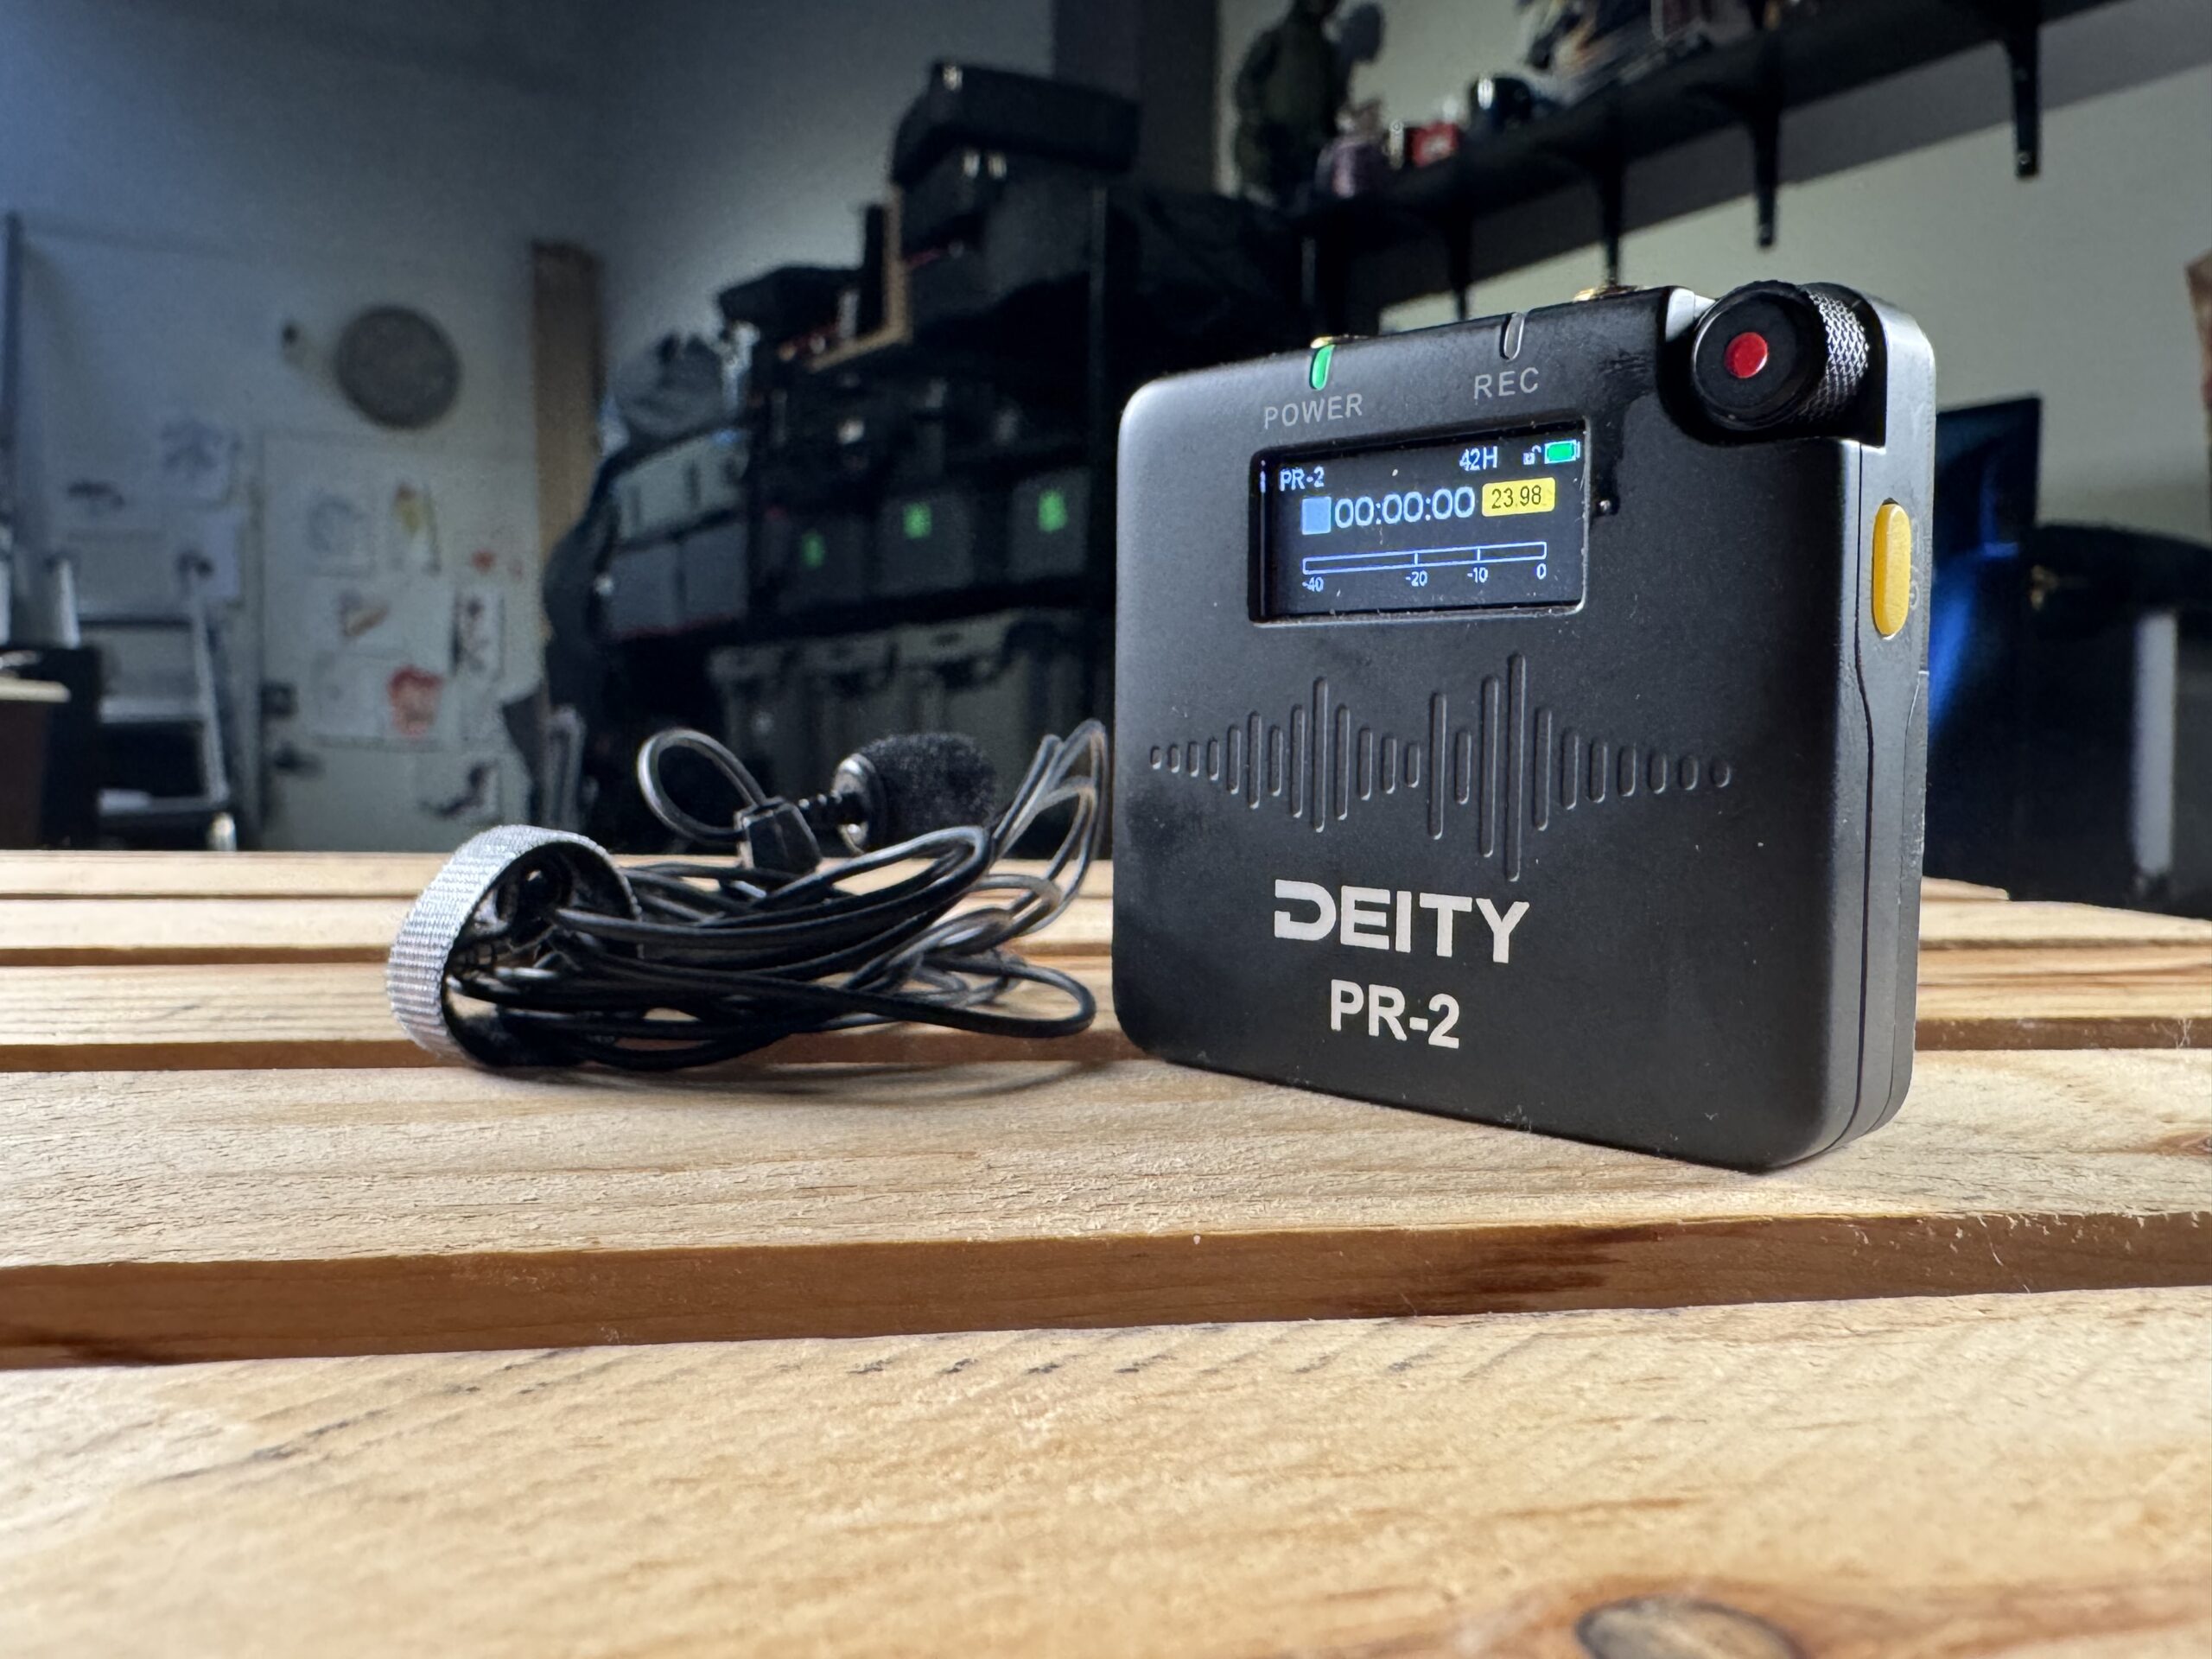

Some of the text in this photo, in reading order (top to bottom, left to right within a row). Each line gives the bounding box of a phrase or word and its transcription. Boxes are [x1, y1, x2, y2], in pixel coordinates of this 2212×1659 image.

[1474, 366, 1540, 400] REC
[1264, 393, 1363, 429] POWER
[1459, 445, 1498, 472] 42H
[1279, 467, 1325, 492] PR-2
[1334, 486, 1476, 529] 00:00:00
[1491, 485, 1542, 510] 23.98
[1301, 563, 1547, 593] -40 -20 -10 0
[1274, 879, 1530, 963] DEITY
[1331, 978, 1459, 1049] PR-2
